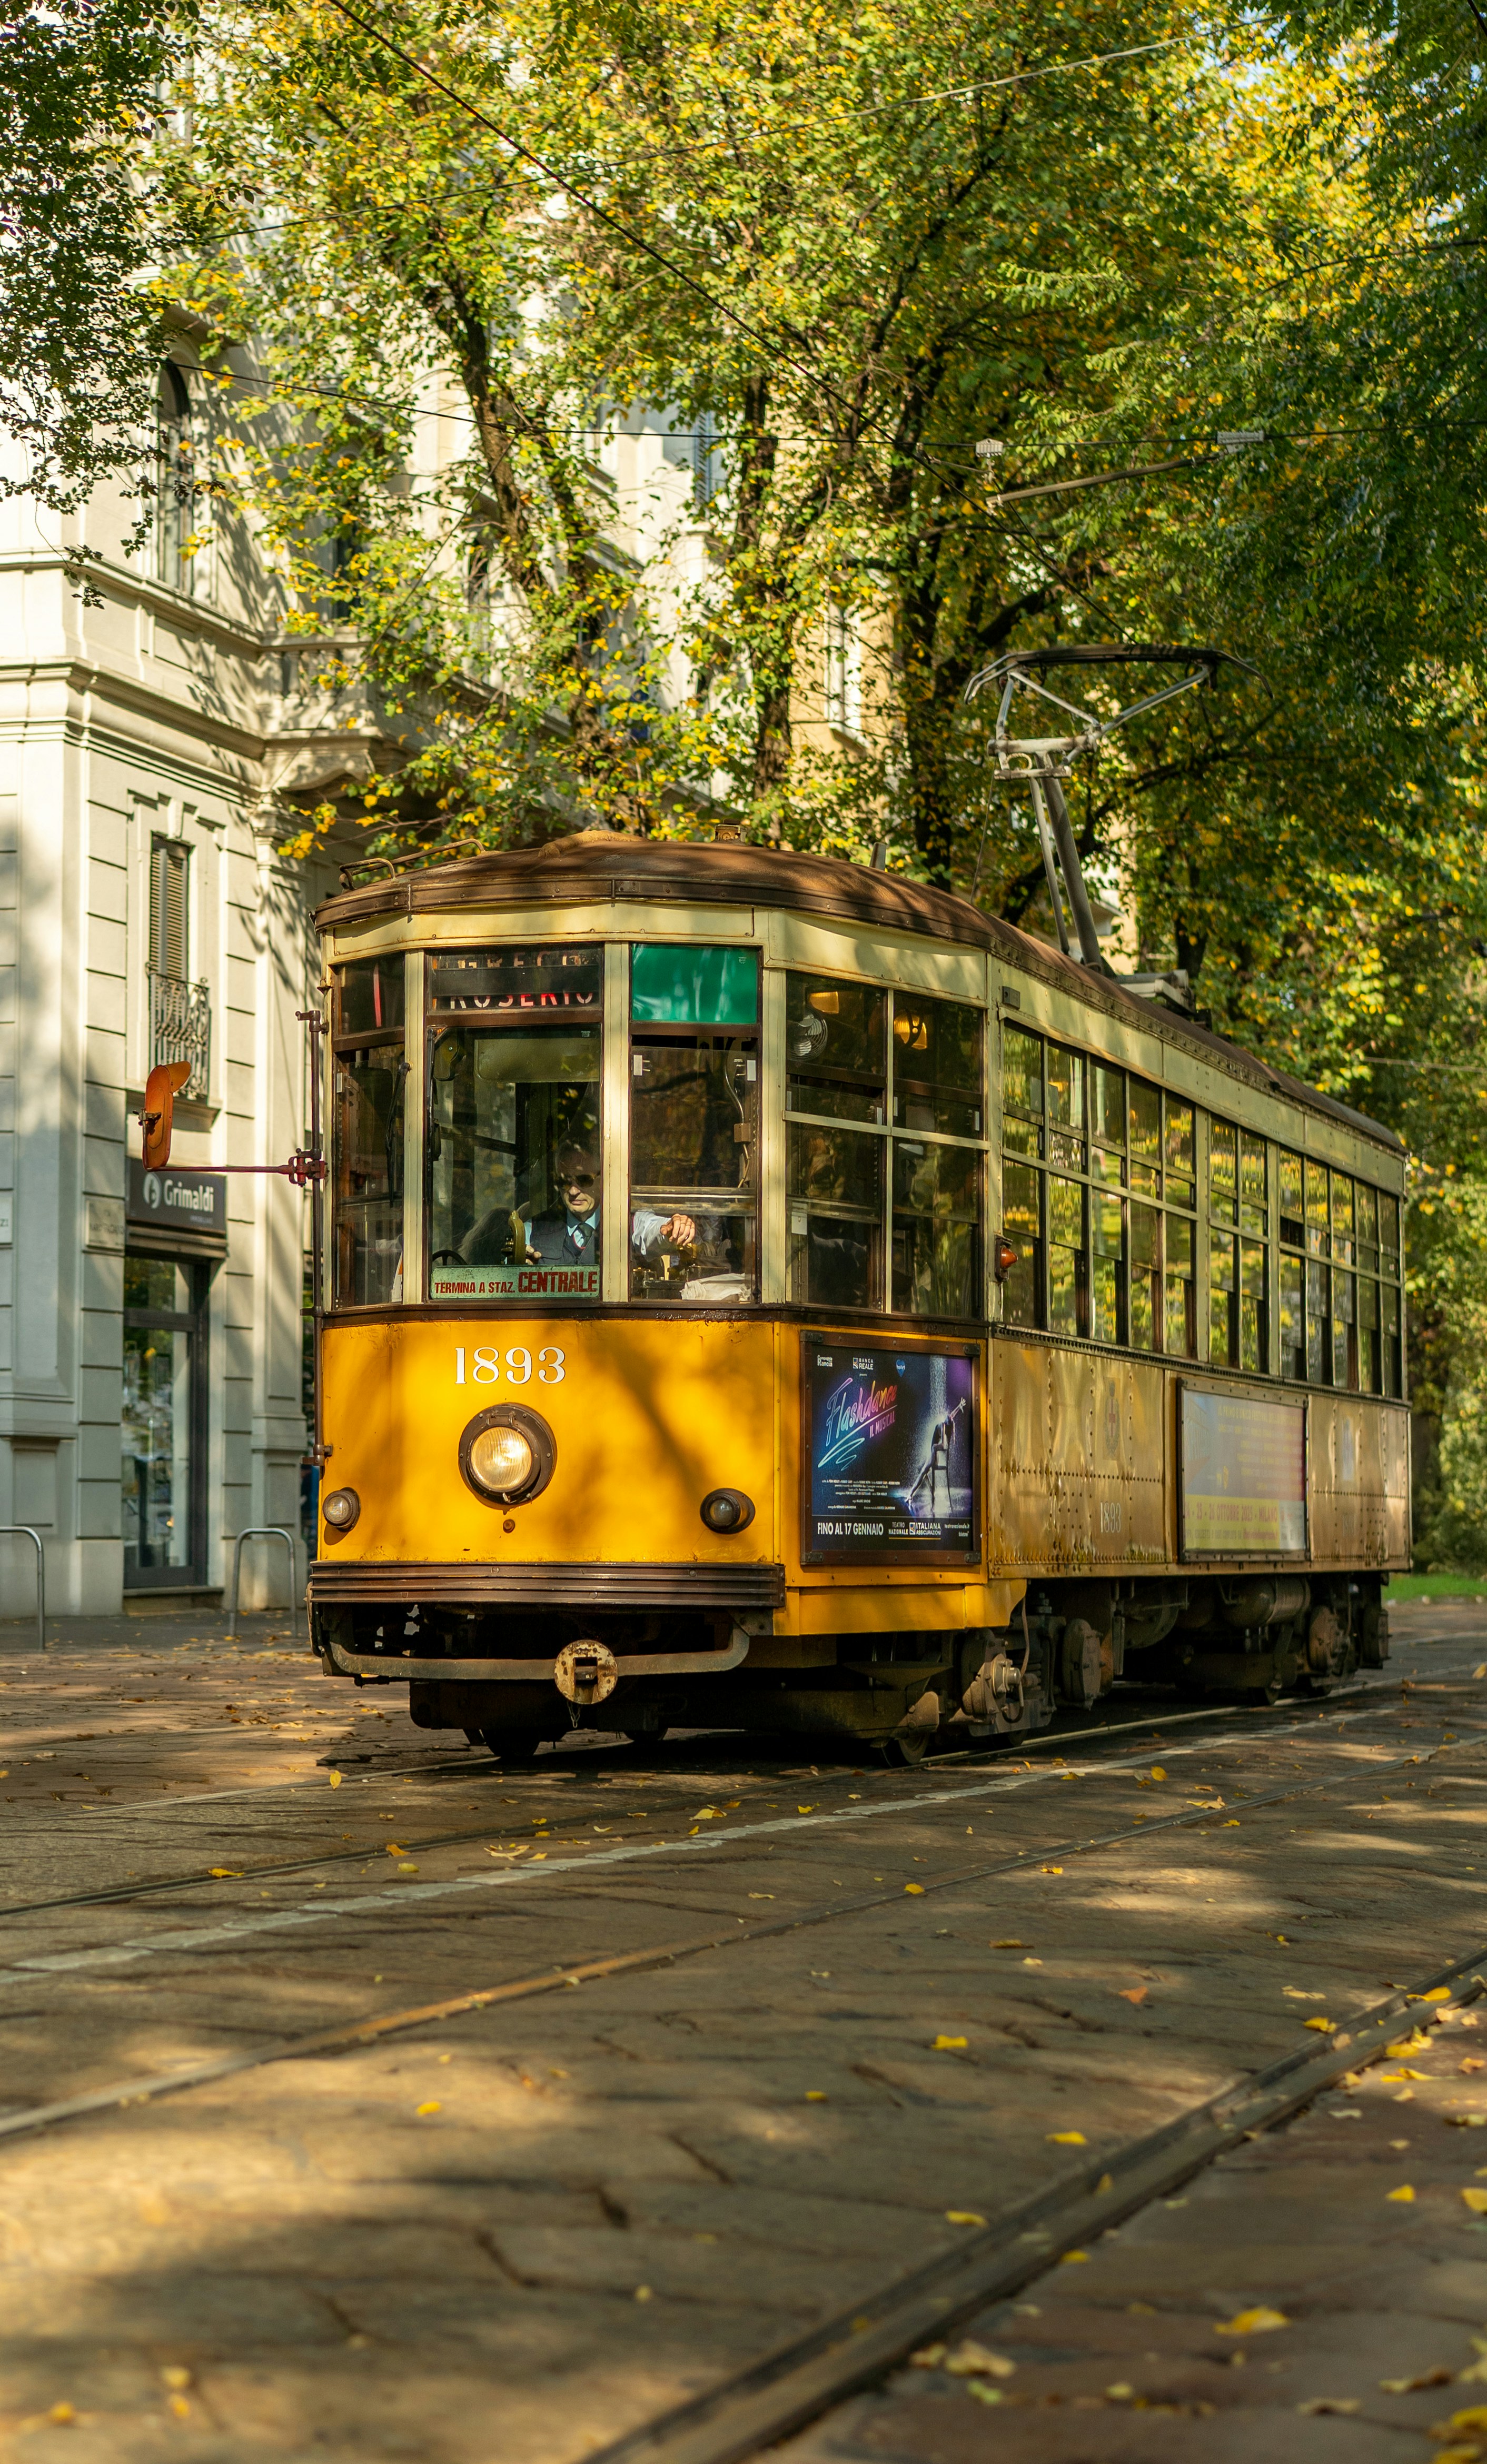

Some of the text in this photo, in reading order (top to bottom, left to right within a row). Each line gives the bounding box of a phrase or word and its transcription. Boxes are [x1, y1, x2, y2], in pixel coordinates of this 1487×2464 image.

[164, 1179, 214, 1212] Grimaldi
[435, 1271, 598, 1294] TERMINA A STAZ. CENTRALE
[454, 1346, 566, 1385] 1893
[826, 1377, 898, 1447] Flashdance
[869, 1411, 896, 1438] IL MUSICAL
[1100, 1502, 1121, 1533] 1893
[1217, 1503, 1239, 1521] OTTOBRE
[1259, 1506, 1277, 1523] MILANO
[817, 1522, 884, 1536] FINO AL 17 GENNAIO
